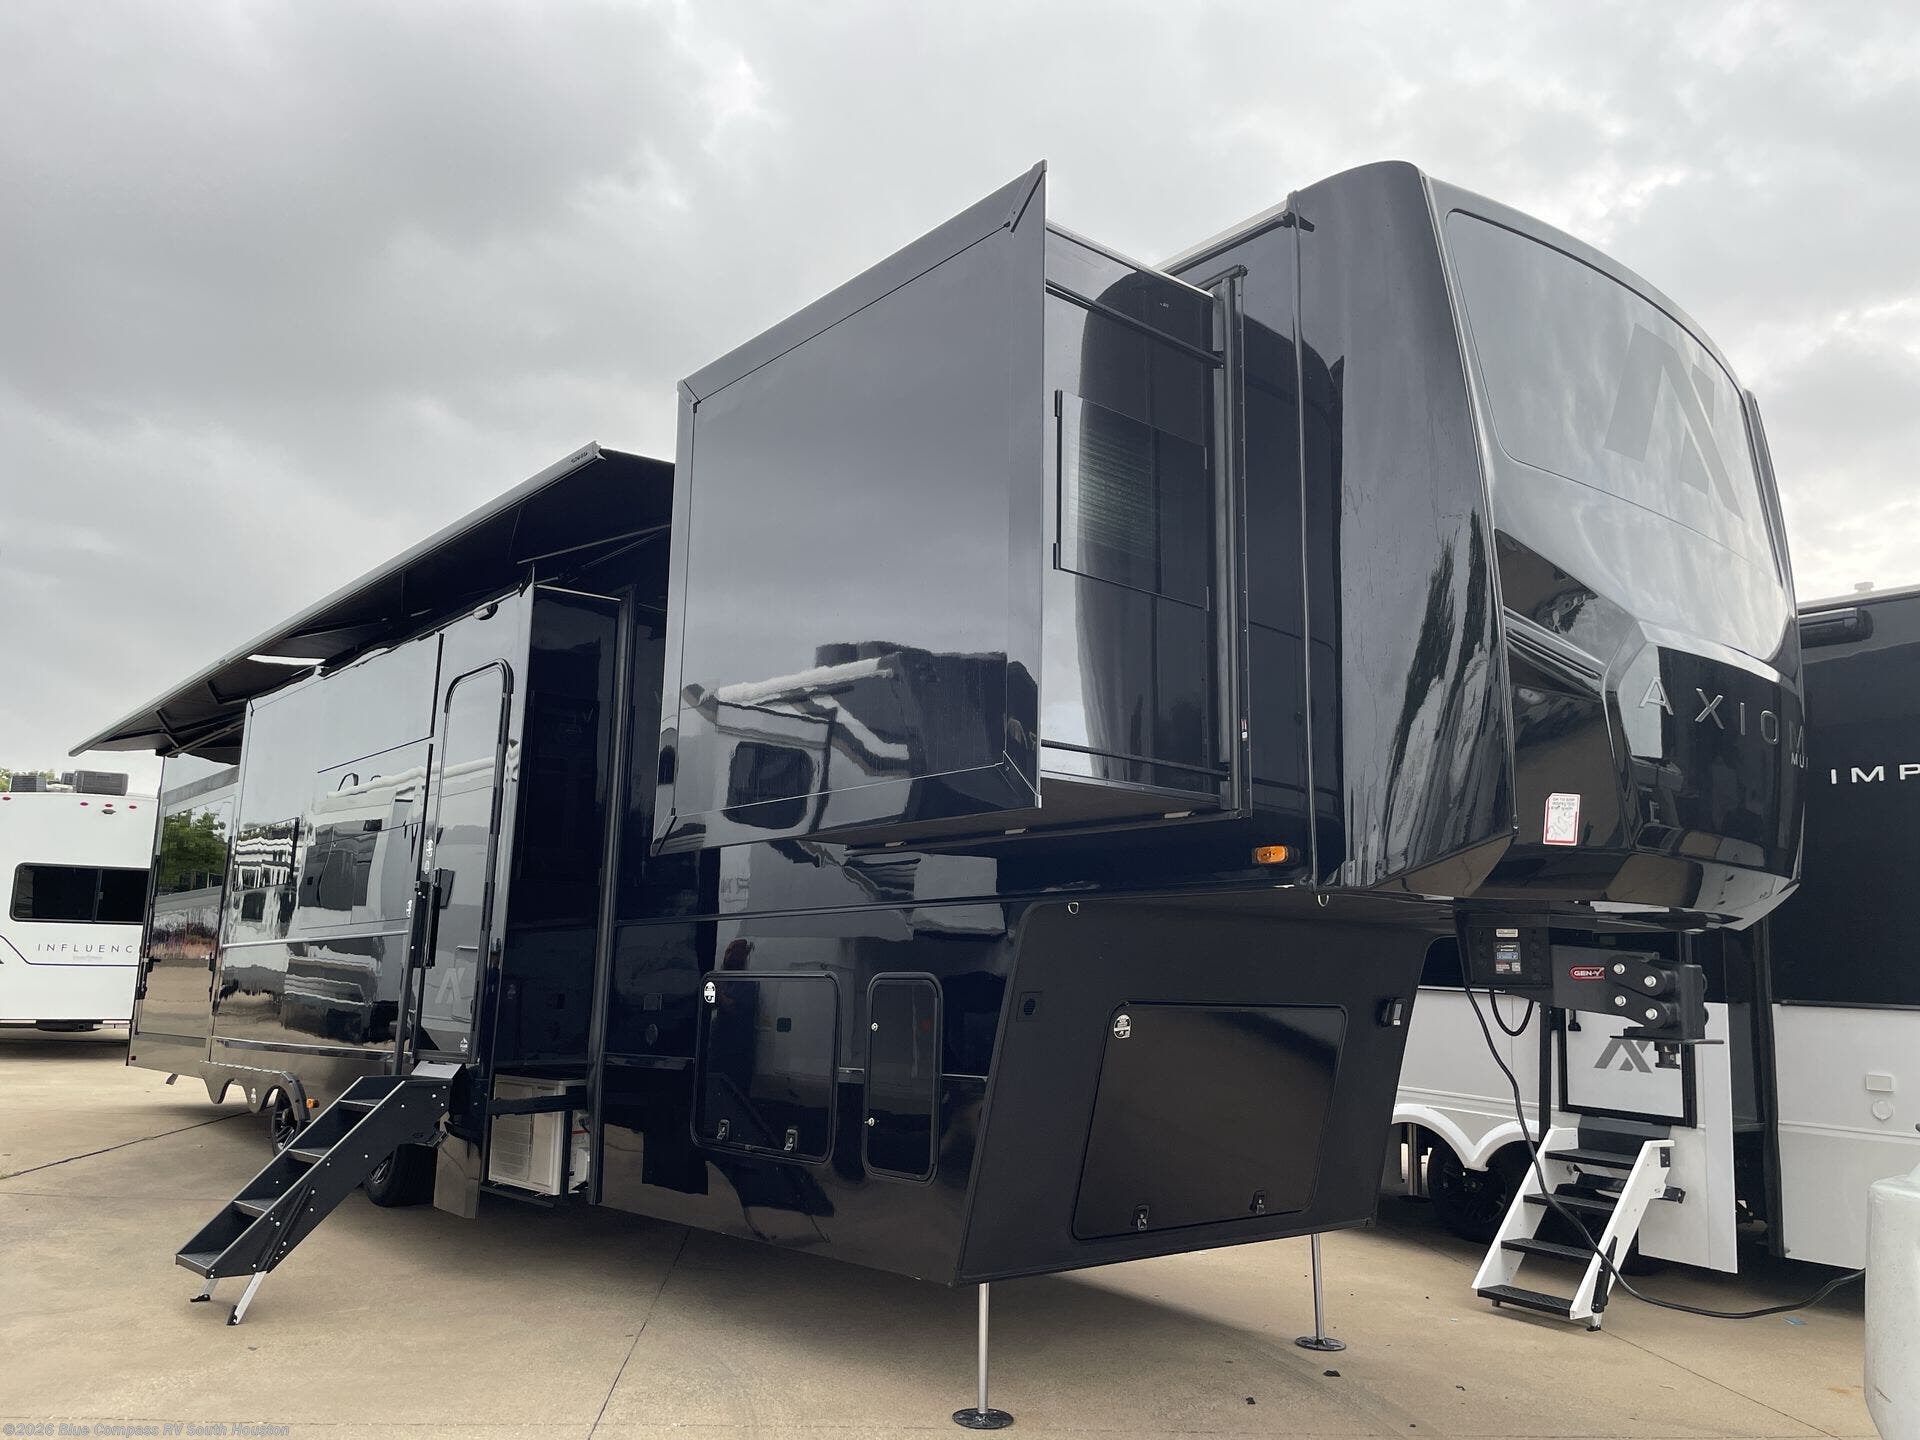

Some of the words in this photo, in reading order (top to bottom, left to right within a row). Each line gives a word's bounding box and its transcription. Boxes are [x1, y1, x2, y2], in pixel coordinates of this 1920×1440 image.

[1639, 677, 1804, 752] AXIOM
[1831, 764, 1920, 784] IMP
[38, 944, 141, 953] INFLUENC
[1573, 967, 1604, 977] GEN-Y
